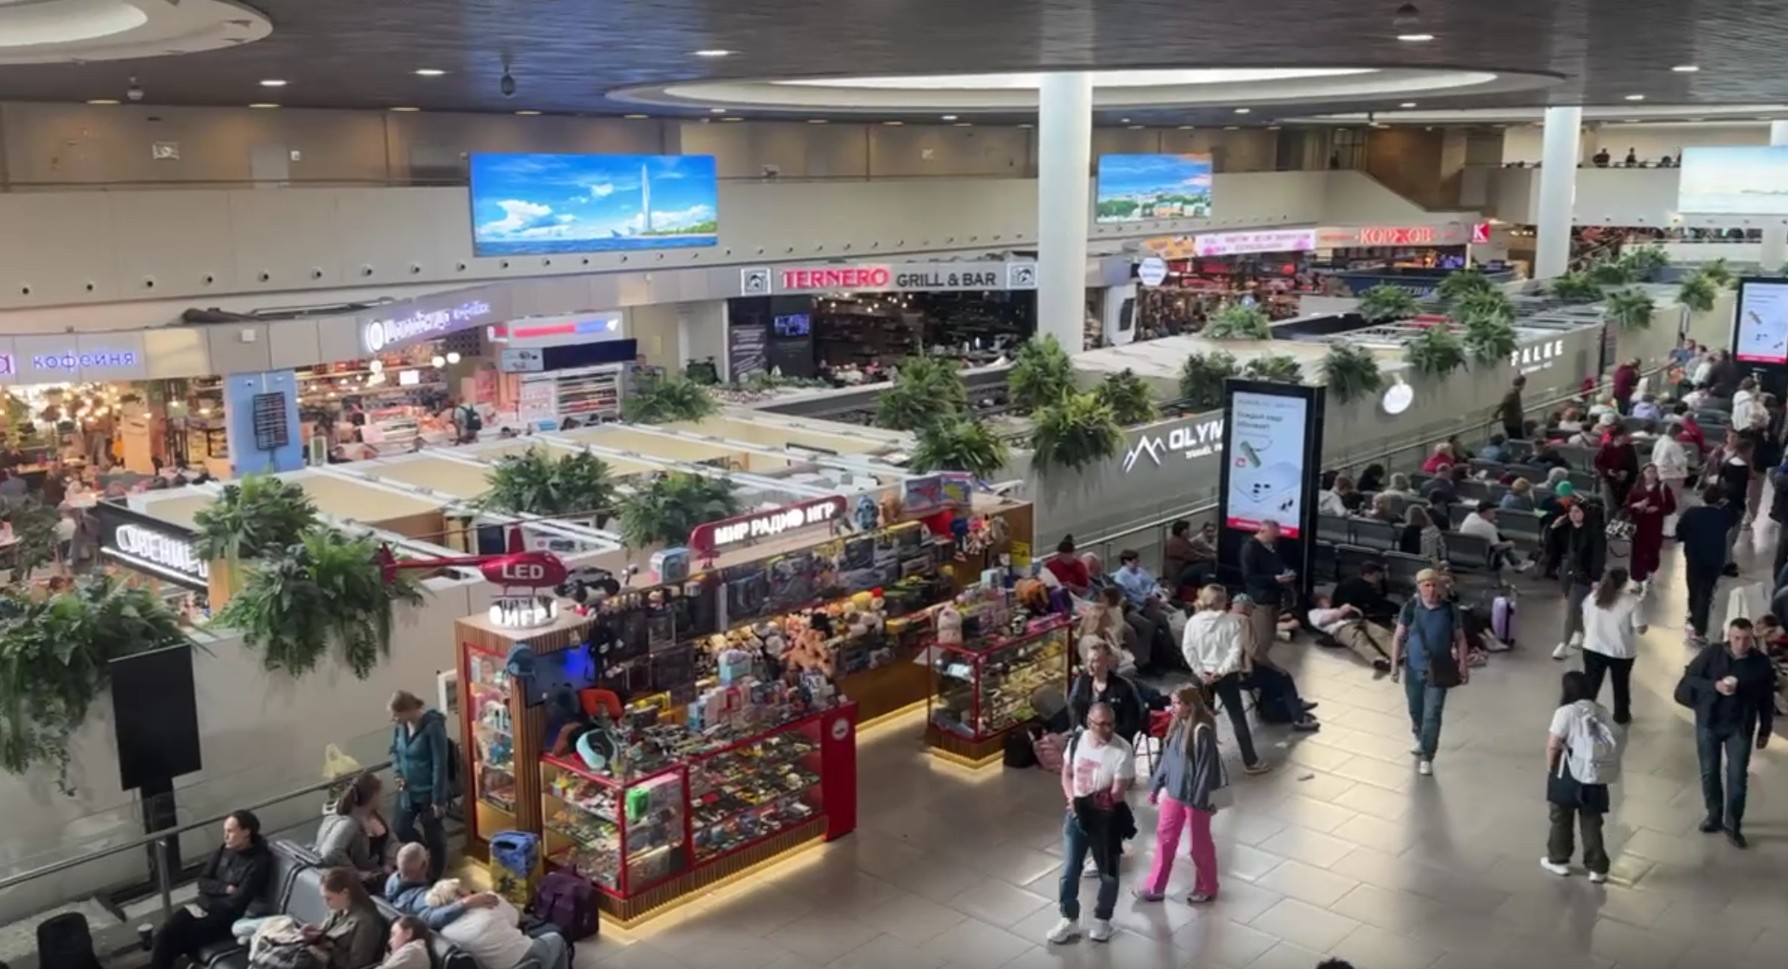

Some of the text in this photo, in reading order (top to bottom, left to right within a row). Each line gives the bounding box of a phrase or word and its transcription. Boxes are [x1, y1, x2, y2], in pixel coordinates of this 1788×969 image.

[782, 268, 996, 289] TERNERO GRILL & BAR
[714, 502, 835, 545] МИР РАДИО ИГР
[502, 562, 544, 579] LED
